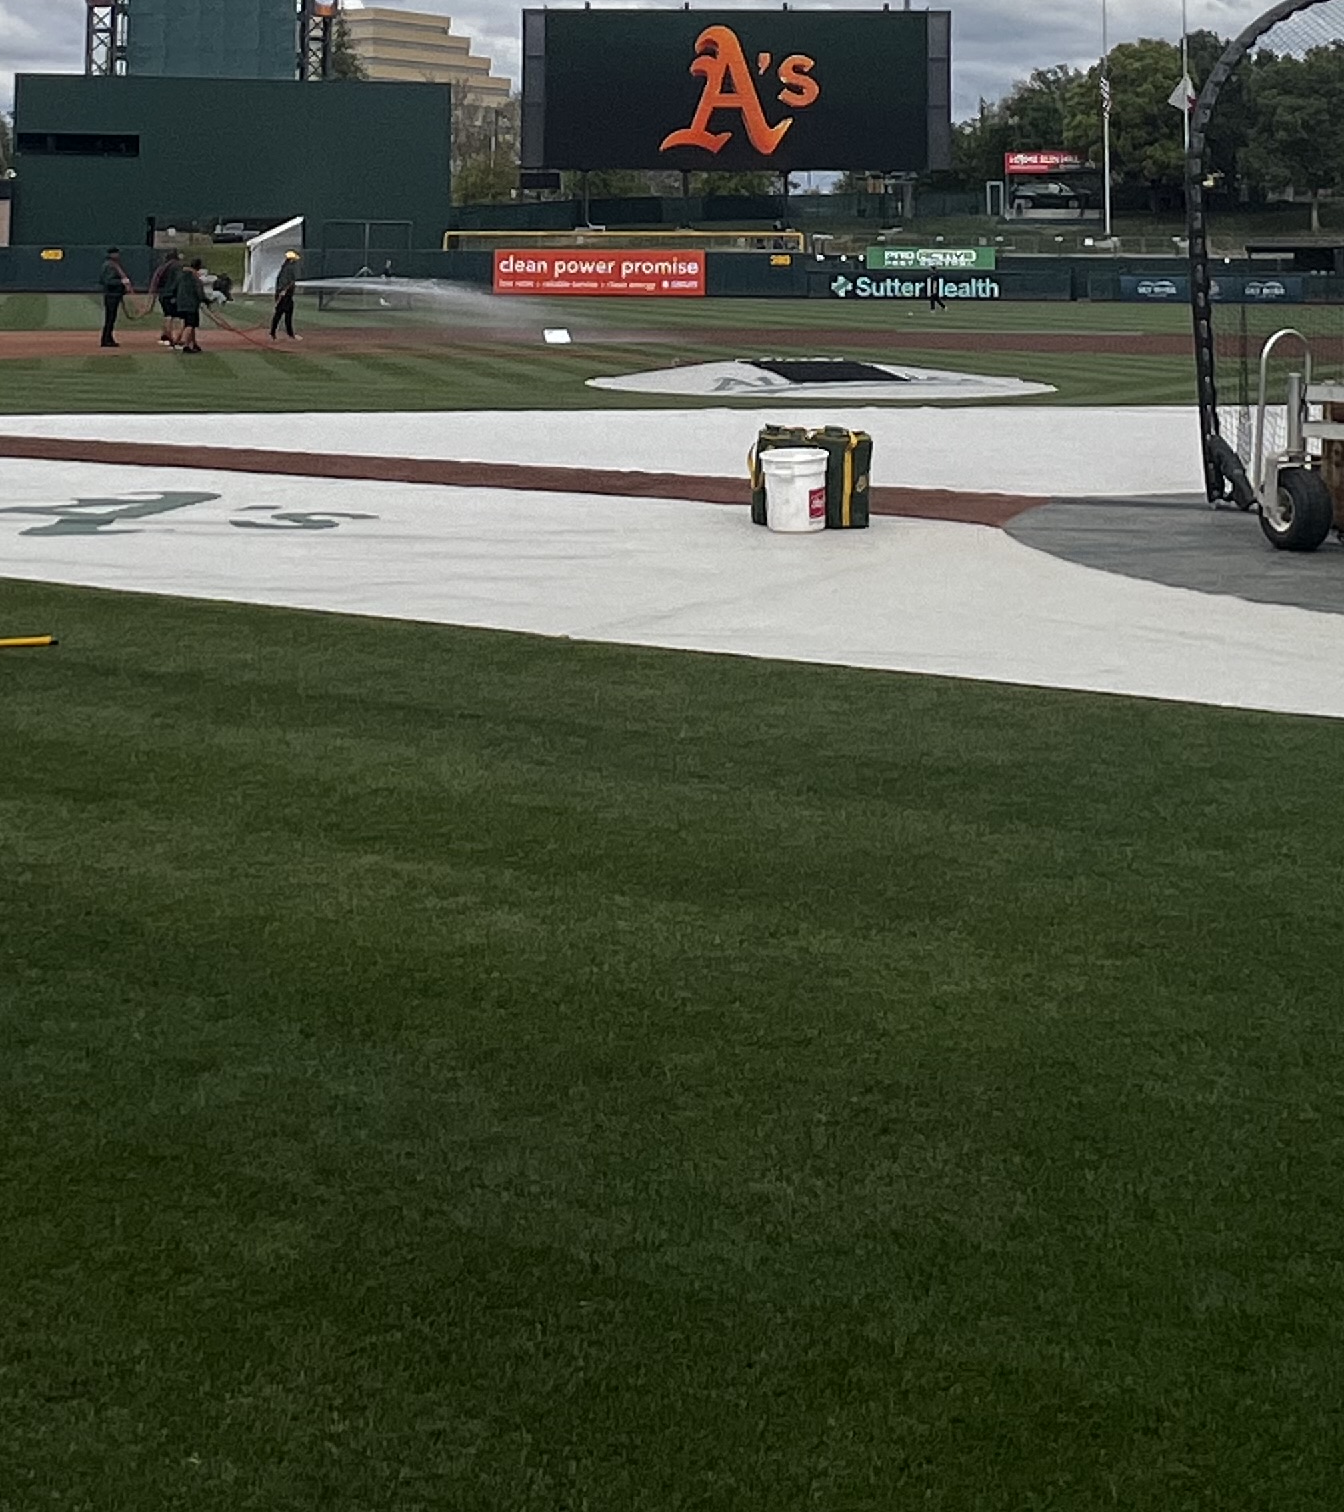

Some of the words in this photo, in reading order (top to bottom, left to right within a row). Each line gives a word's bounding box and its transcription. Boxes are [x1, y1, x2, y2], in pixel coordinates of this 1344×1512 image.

[659, 24, 820, 156] A's
[498, 254, 548, 275] clean
[553, 259, 616, 279] power
[620, 256, 700, 279] promise
[855, 276, 925, 298] Sutter
[926, 276, 1001, 299] Health
